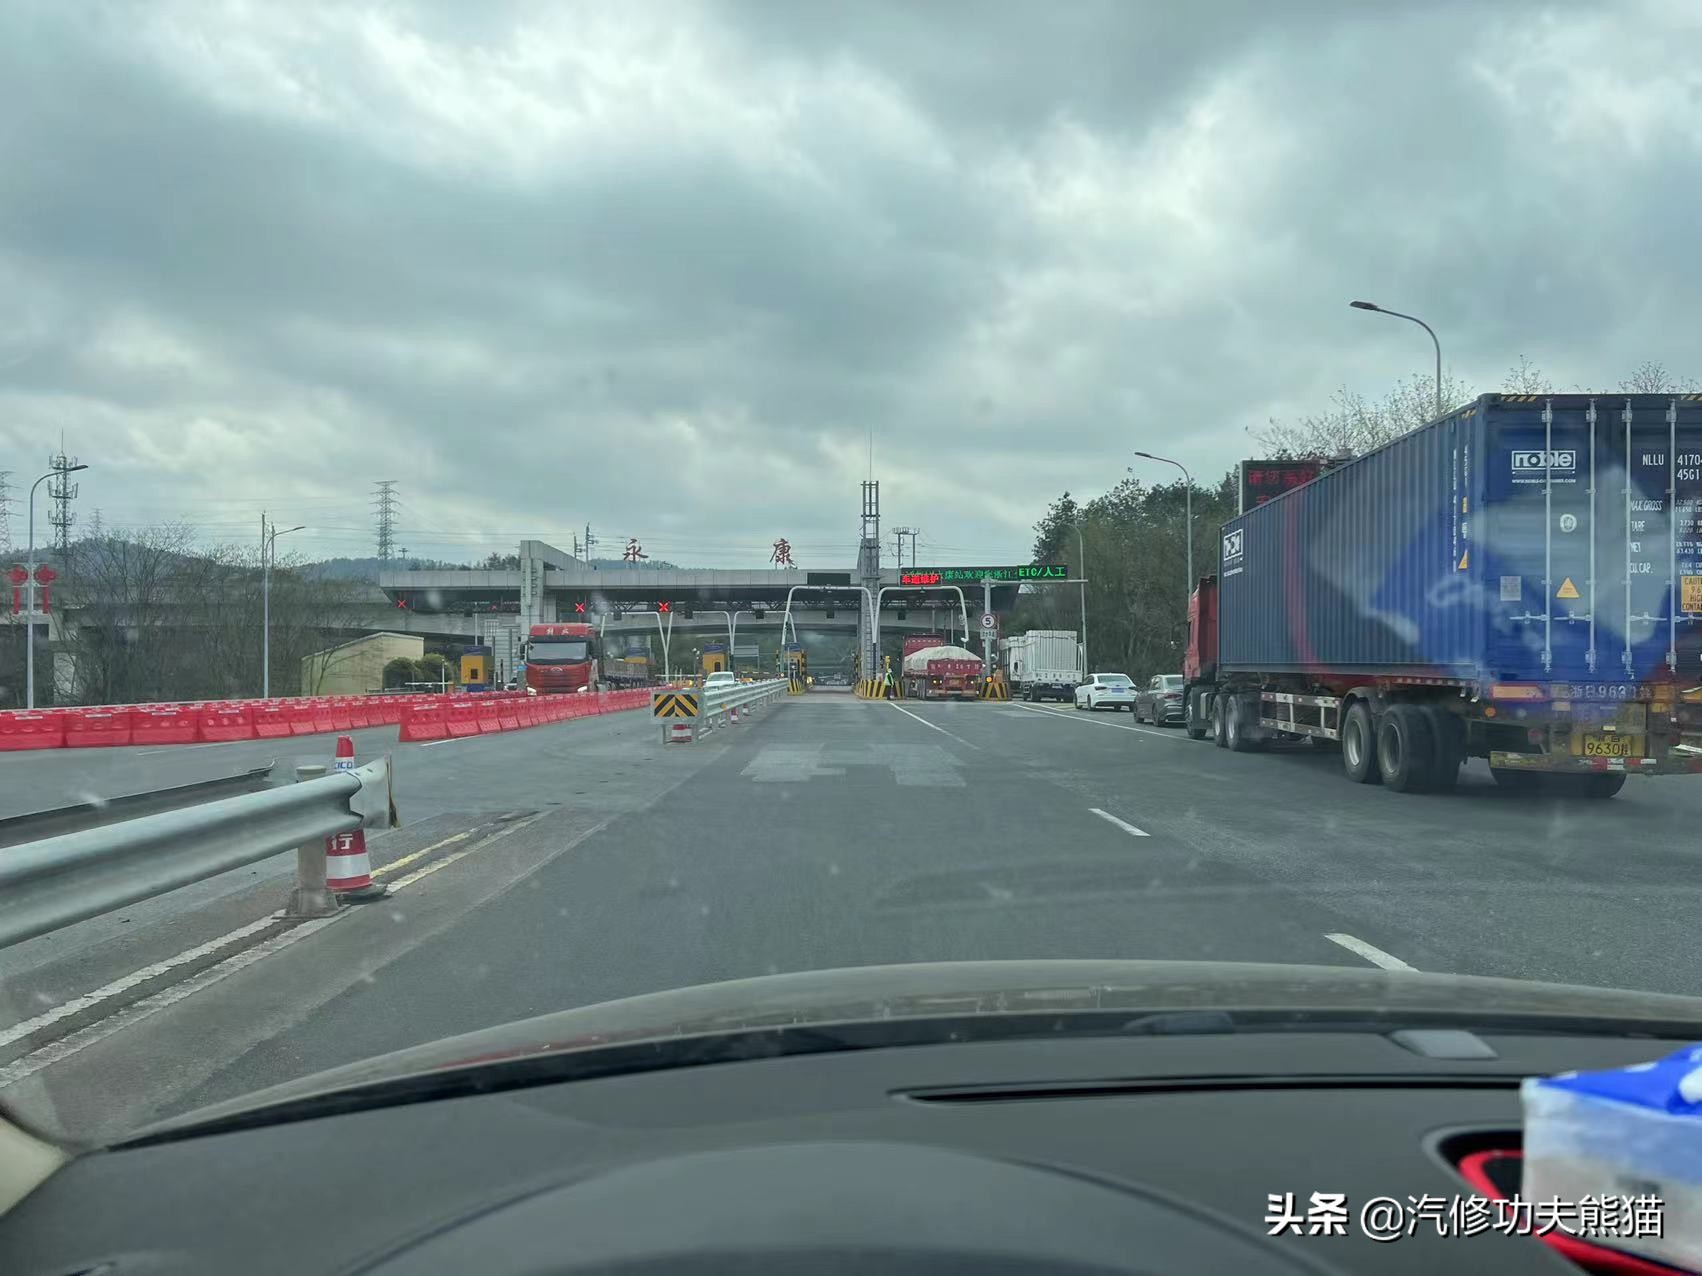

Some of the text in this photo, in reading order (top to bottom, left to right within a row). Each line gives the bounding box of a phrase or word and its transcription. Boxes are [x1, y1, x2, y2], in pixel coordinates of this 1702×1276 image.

[1642, 454, 1664, 466] NLLU
[1676, 468, 1699, 480] 45G1
[1018, 566, 1066, 578] ETC/人工
[984, 617, 992, 626] 5
